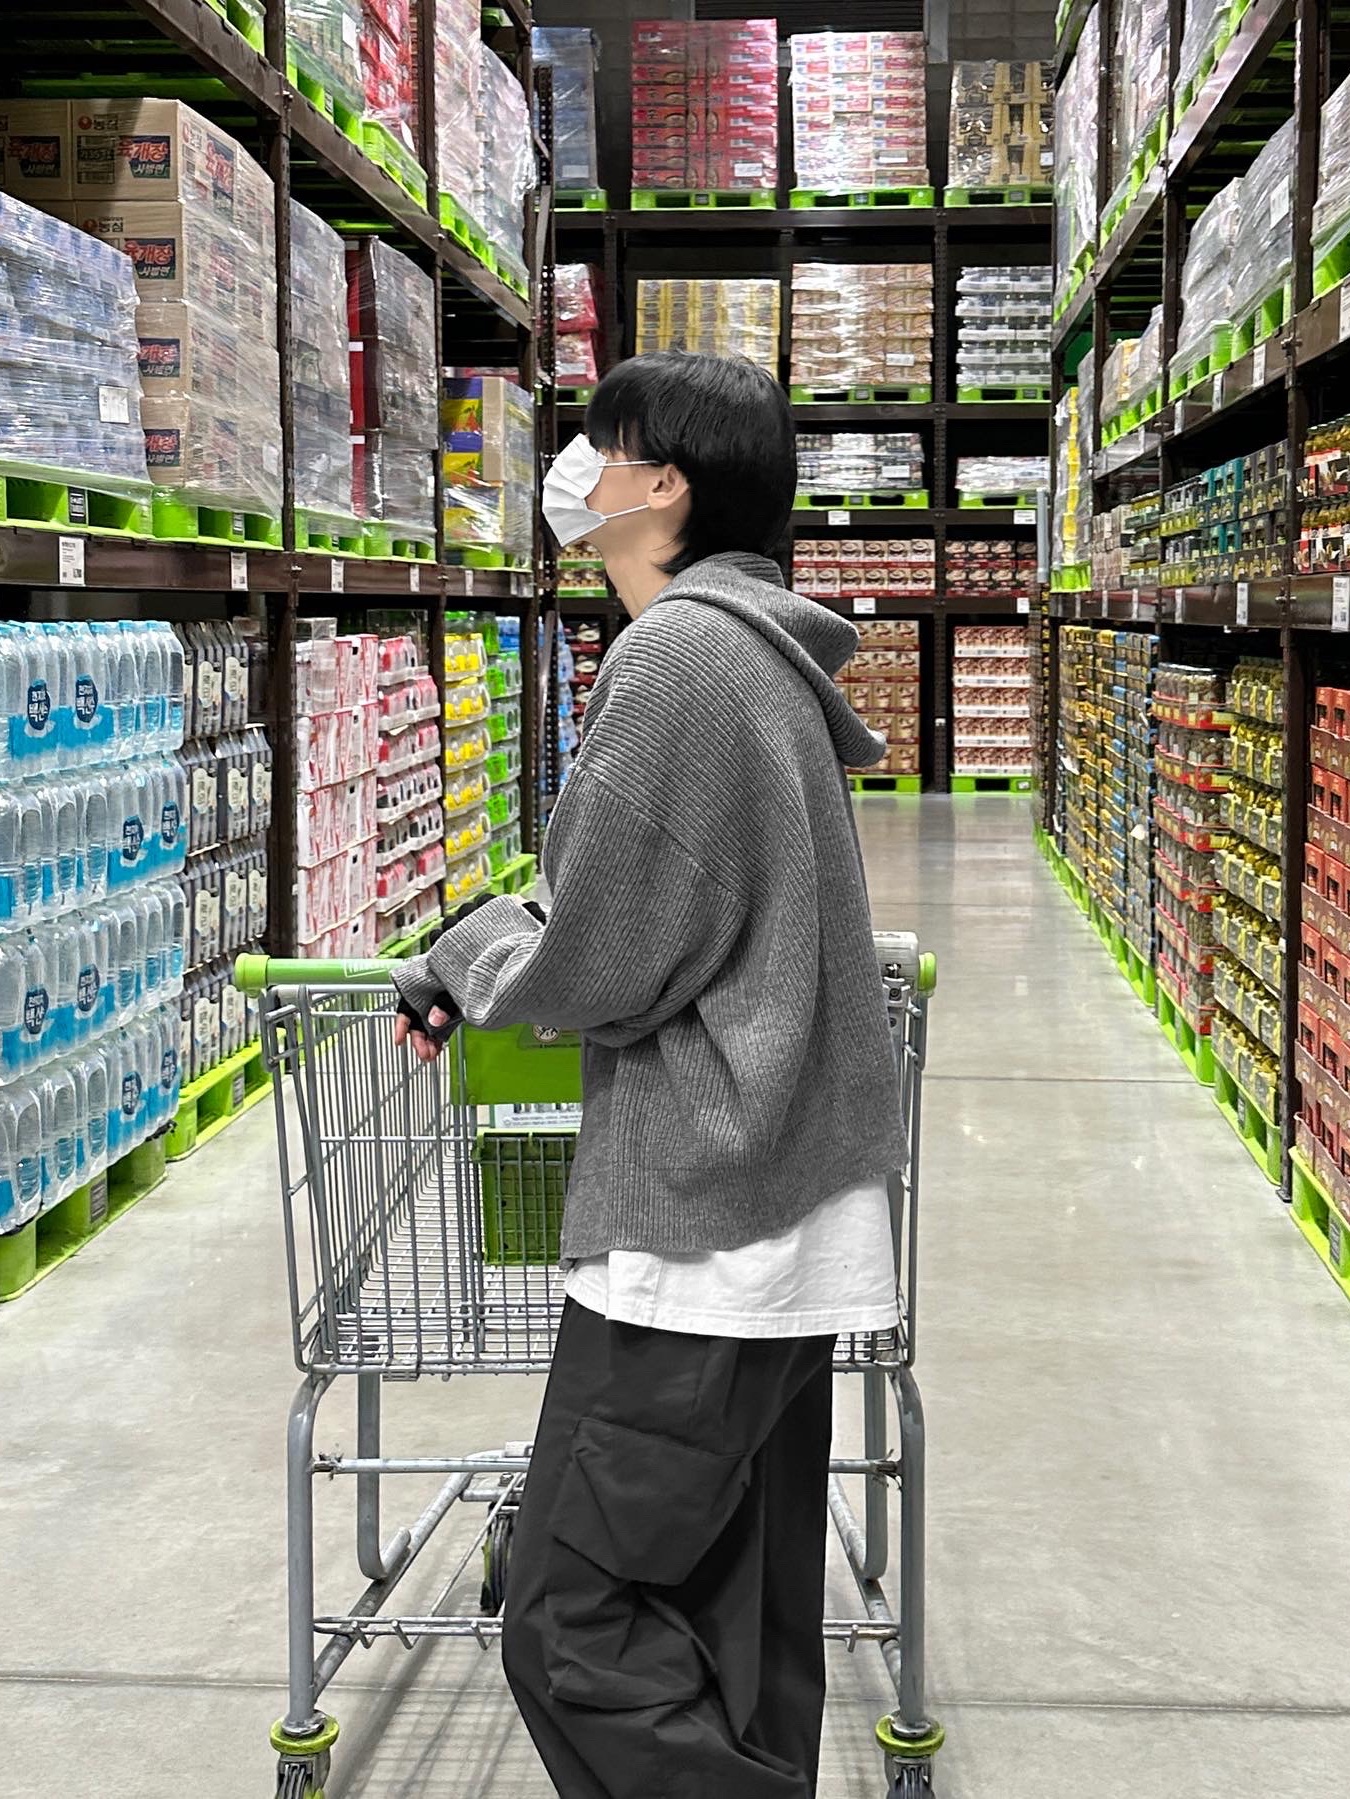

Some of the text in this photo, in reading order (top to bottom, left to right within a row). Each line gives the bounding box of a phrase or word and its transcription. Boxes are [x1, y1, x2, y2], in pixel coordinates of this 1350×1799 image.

[117, 137, 169, 162] 육개장
[122, 240, 174, 265] 육개장
[139, 343, 179, 364] 개장
